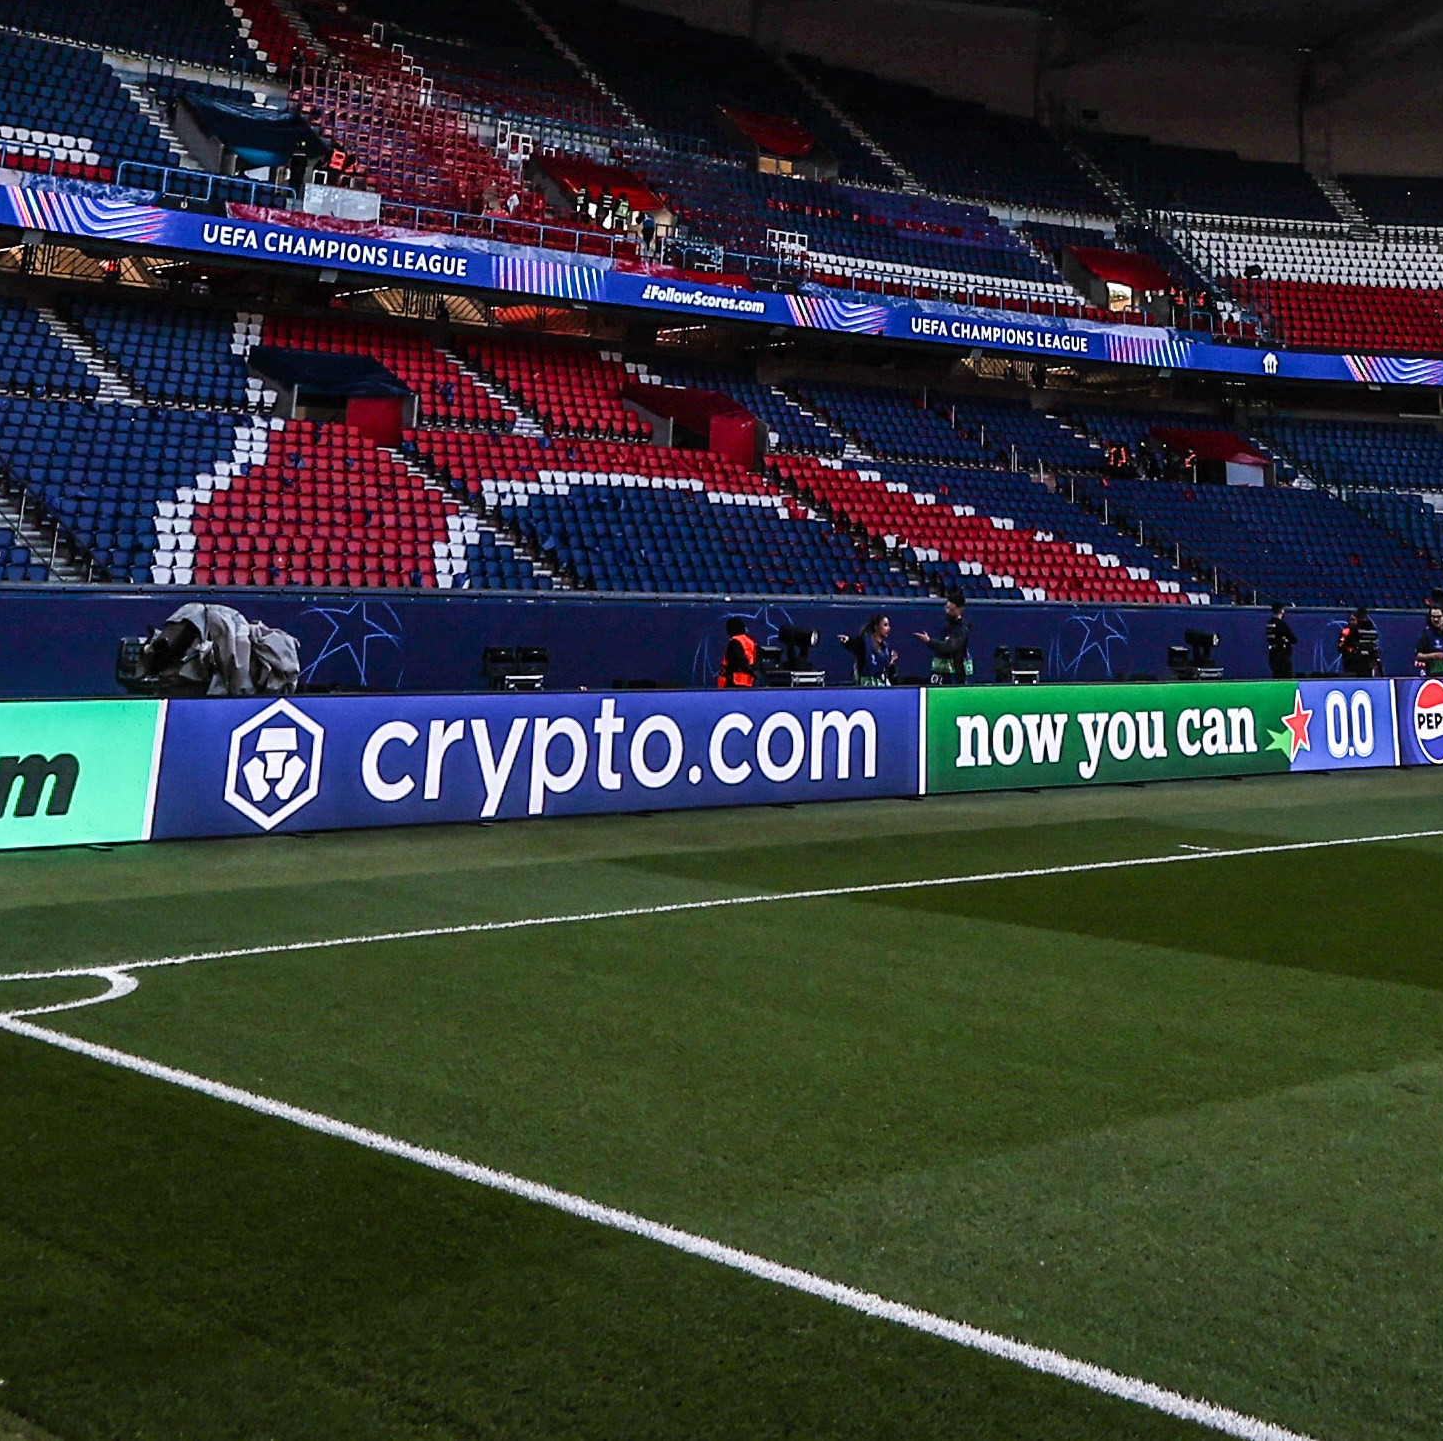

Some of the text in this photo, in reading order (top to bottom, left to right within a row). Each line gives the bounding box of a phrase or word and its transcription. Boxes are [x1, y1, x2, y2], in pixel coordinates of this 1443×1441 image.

[203, 223, 467, 277] UEFA CHAMPIONS LEAGUE
[650, 285, 765, 314] FollowScores.com
[911, 317, 1088, 352] UEFA CHAMPIONS LEAGUE
[955, 706, 1258, 780] now you can
[1324, 689, 1375, 758] 0.0
[361, 698, 877, 819] crypto.com
